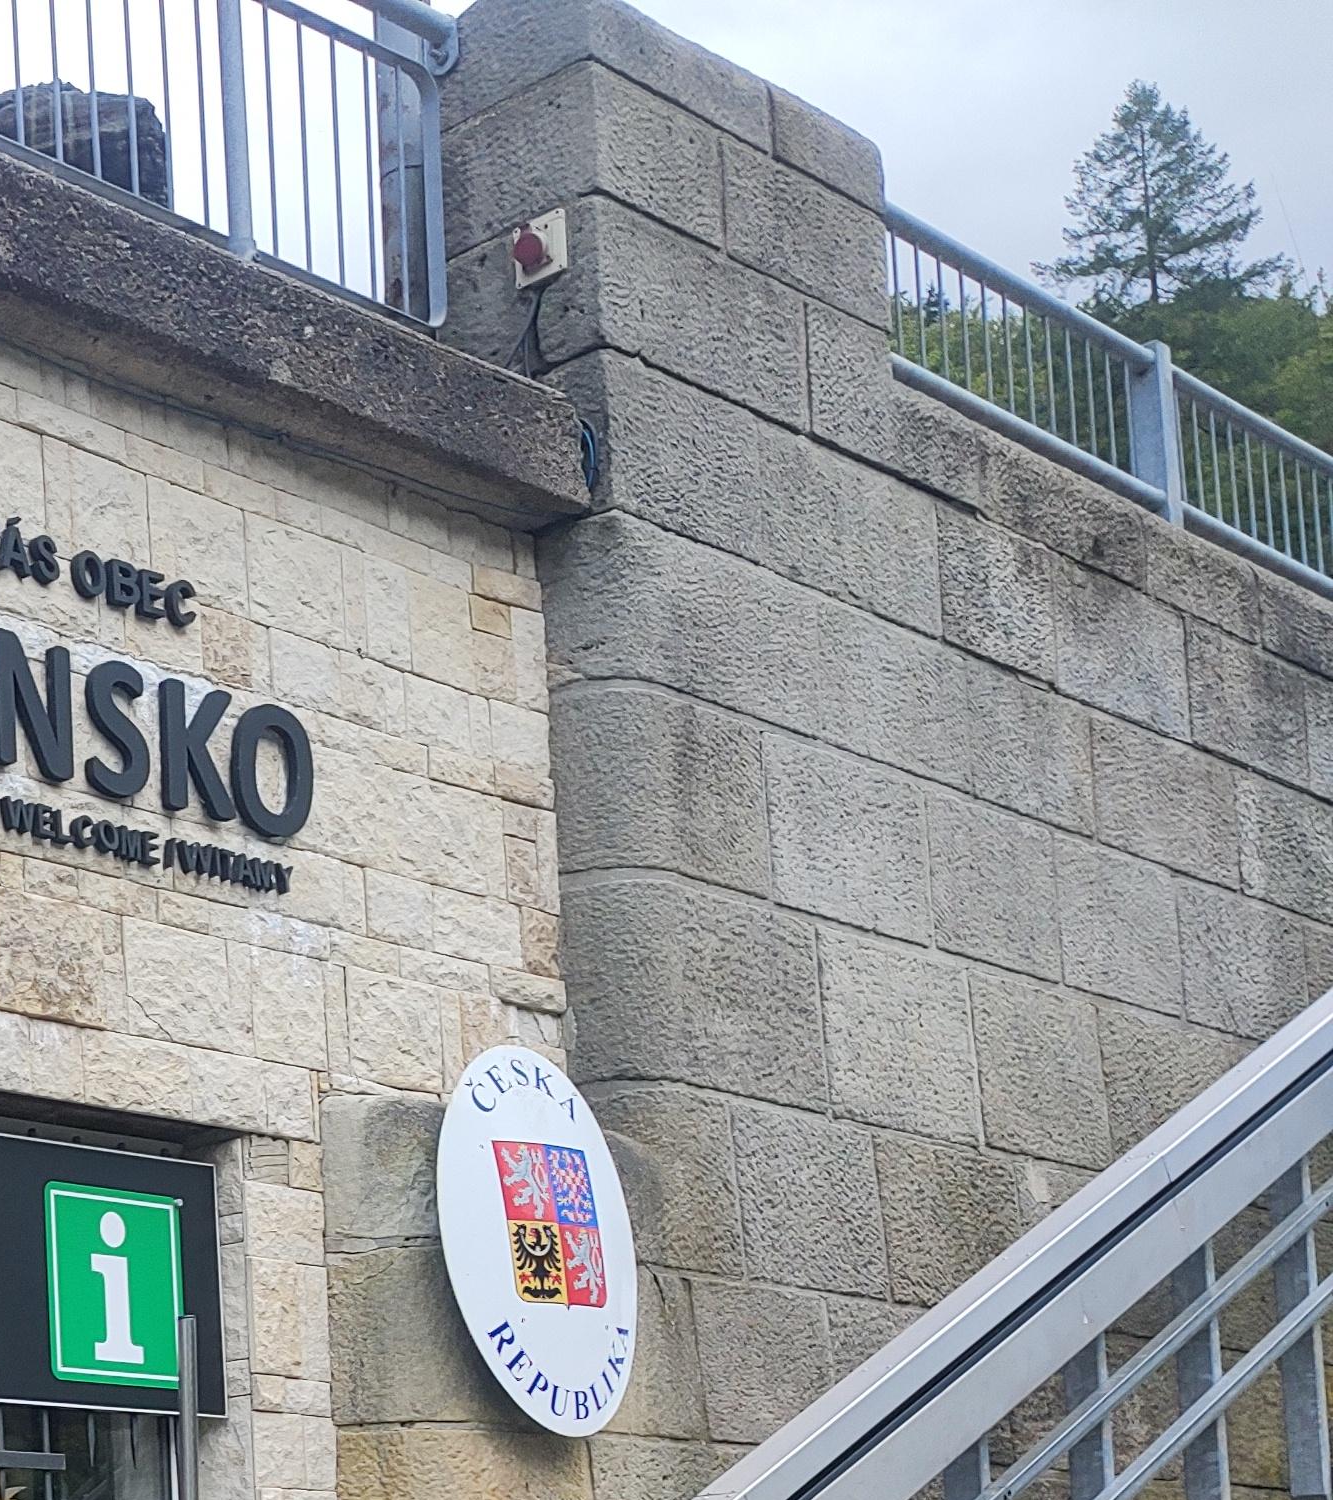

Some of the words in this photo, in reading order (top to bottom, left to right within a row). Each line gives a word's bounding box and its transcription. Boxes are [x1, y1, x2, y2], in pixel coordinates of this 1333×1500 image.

[70, 549, 197, 628] OBEC
[0, 795, 160, 867] WELCOME
[179, 840, 294, 895] WITAMY
[464, 1057, 579, 1124] ČESKÁ
[486, 1318, 630, 1422] REPUBLIKA
